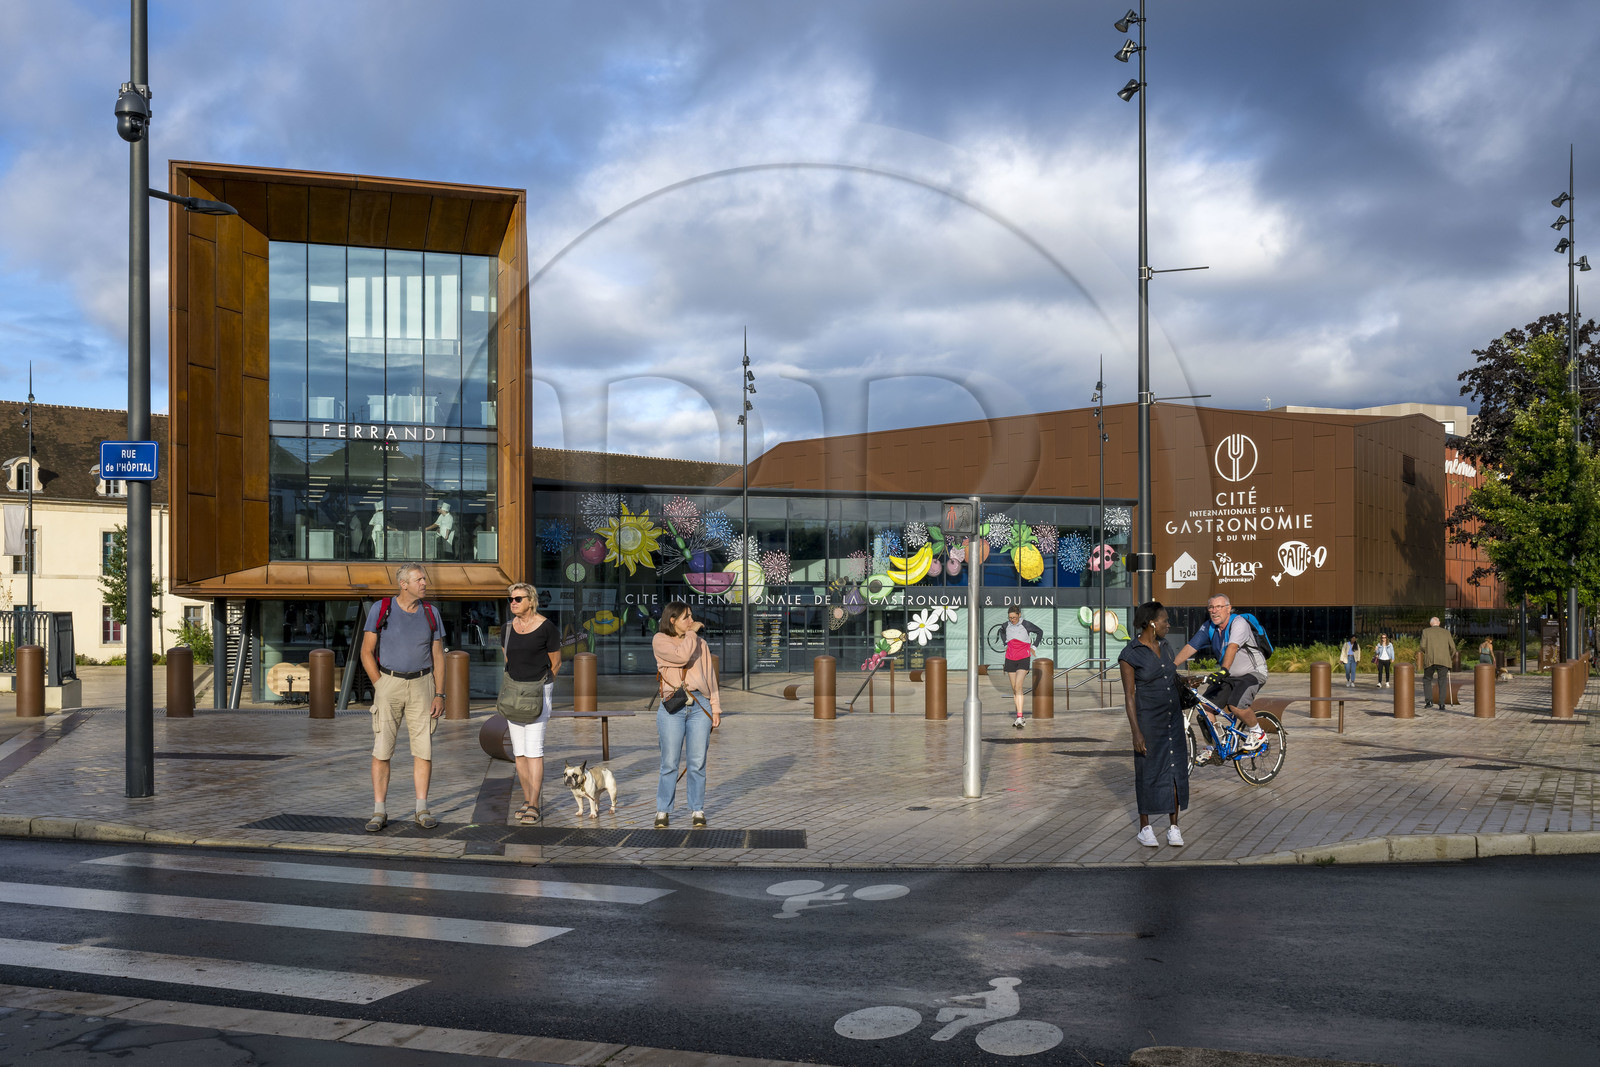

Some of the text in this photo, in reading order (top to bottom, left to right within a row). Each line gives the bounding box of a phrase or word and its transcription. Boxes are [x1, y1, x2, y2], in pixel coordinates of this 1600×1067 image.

[322, 423, 446, 441] FERRANDI
[121, 449, 136, 459] RUE
[105, 461, 152, 472] de l'HÔPITAL
[1215, 486, 1257, 506] CITÉ
[1189, 506, 1285, 518] INTERNATIONALE DE LA
[1165, 514, 1313, 535] GASTRONOMIE
[1241, 534, 1257, 542] VIN
[1179, 569, 1197, 579] 1204
[1209, 559, 1263, 581] Village
[625, 594, 658, 605] CITE
[814, 595, 832, 606] DE
[843, 595, 858, 606] LA
[868, 595, 968, 606] GASTRONOMI
[985, 596, 993, 606] &
[1004, 596, 1022, 606] DU
[1030, 596, 1055, 606] VIN
